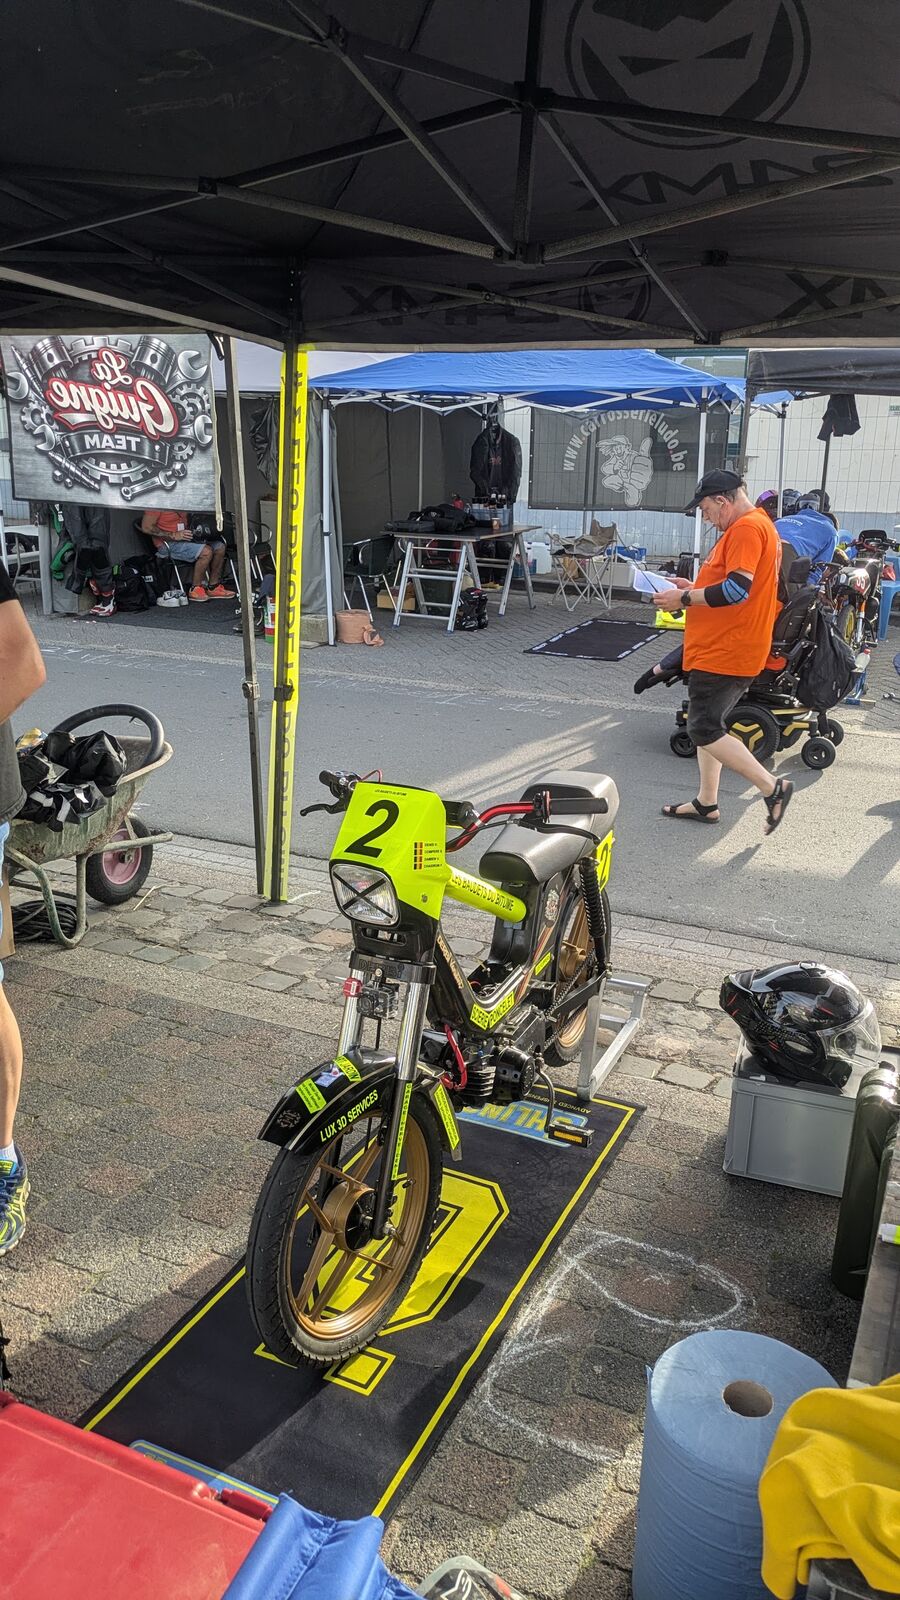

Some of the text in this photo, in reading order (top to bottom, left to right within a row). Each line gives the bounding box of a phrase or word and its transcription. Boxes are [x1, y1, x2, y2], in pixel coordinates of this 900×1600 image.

[563, 409, 688, 472] www.carrosserieludo.be
[343, 799, 400, 859] 2
[451, 876, 515, 912] LES BAUDETS DU BITUME
[320, 1120, 338, 1142] LUX
[337, 1116, 348, 1131] 3D
[346, 1088, 379, 1123] SERVICES
